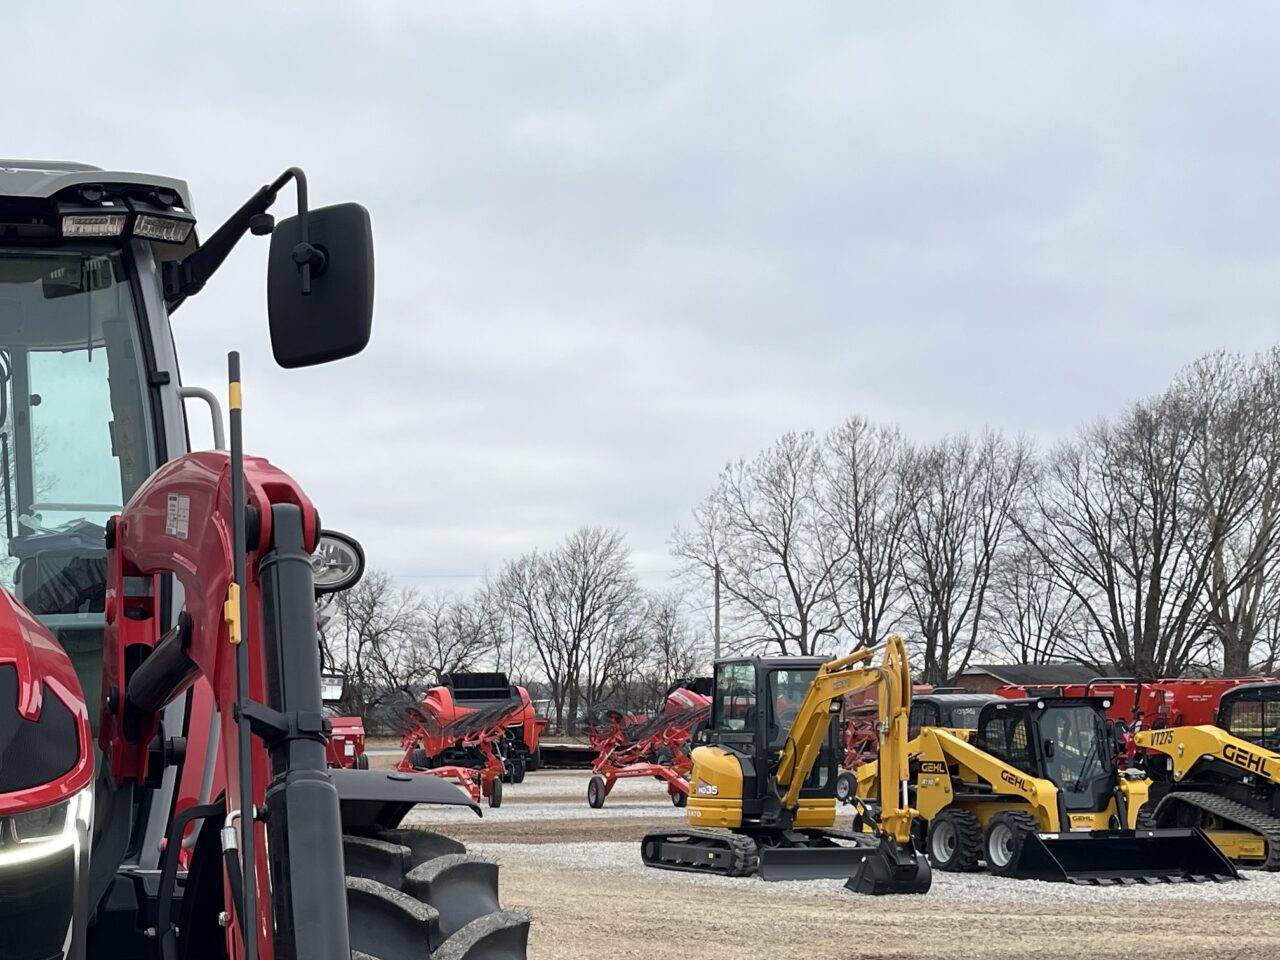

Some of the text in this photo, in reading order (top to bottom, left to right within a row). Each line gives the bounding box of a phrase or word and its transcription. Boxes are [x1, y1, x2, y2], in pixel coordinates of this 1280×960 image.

[1150, 730, 1174, 746] VT275
[921, 763, 945, 773] GEHL
[1223, 743, 1271, 777] GEHL
[1001, 770, 1028, 792] GEHL
